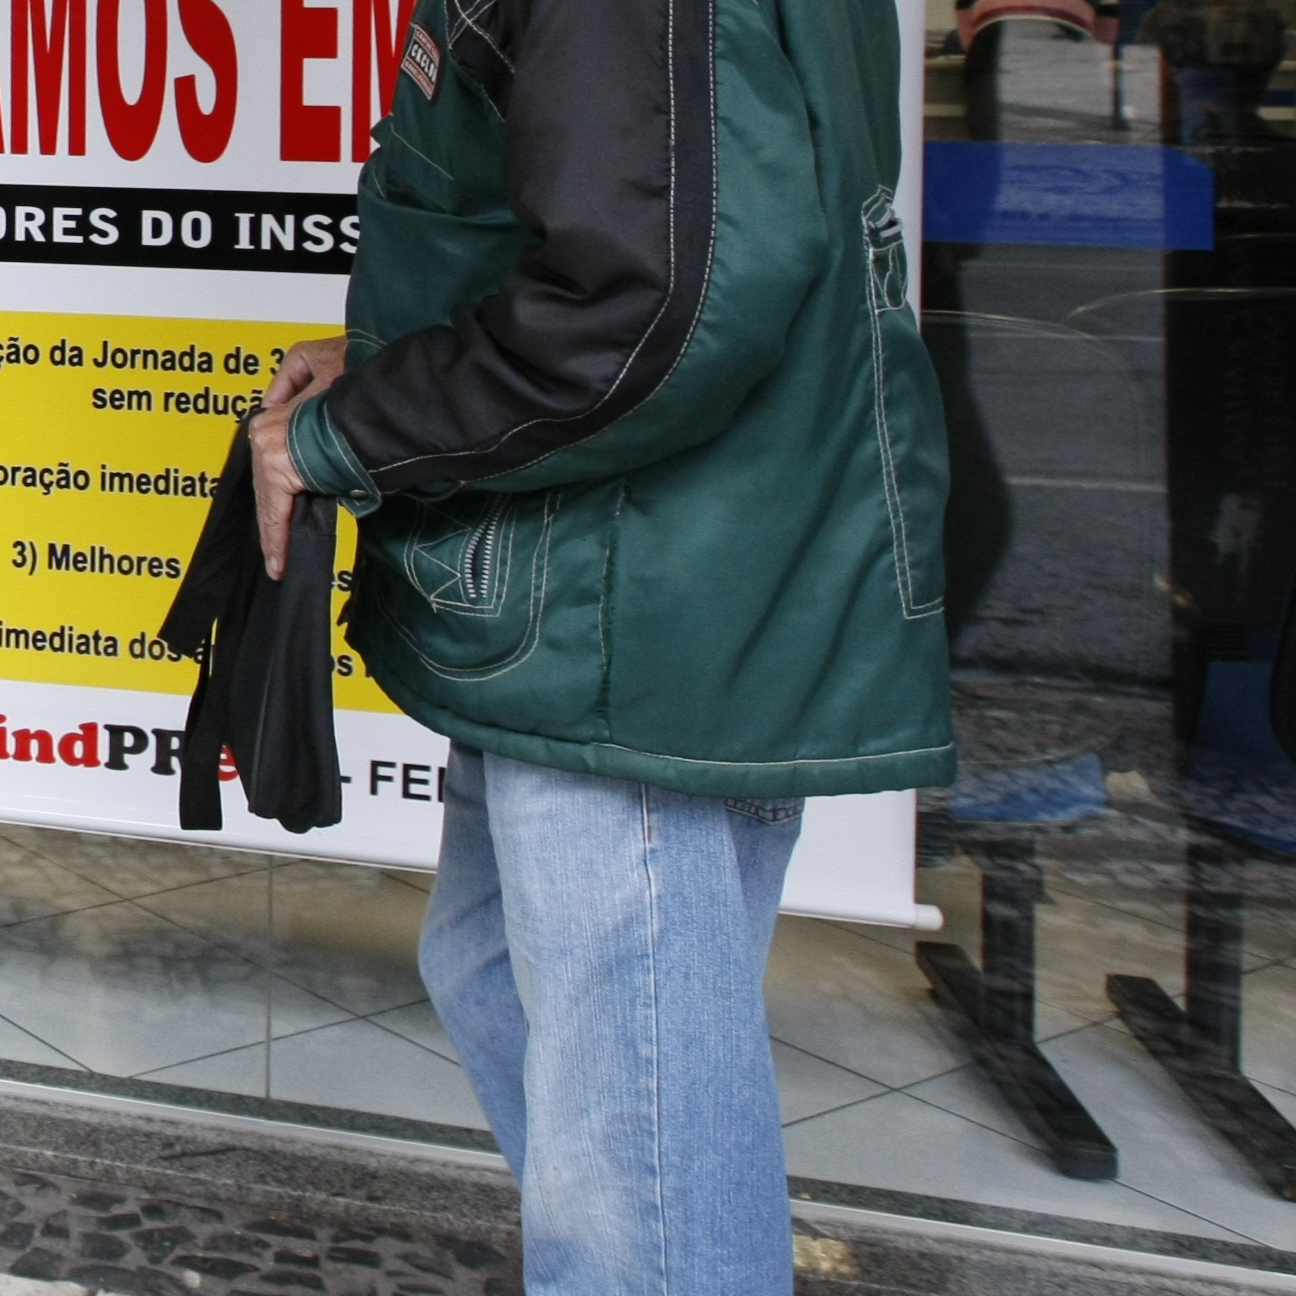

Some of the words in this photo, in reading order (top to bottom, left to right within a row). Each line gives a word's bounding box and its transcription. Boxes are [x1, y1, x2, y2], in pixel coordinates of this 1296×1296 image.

[141, 209, 213, 249] DO
[234, 213, 361, 254] INSS
[49, 339, 84, 367] da
[92, 340, 214, 374] Jornada
[223, 346, 261, 376] de
[91, 387, 153, 412] sem
[11, 539, 38, 576] 3)
[47, 542, 181, 579] Melhores
[369, 759, 447, 803] FE
